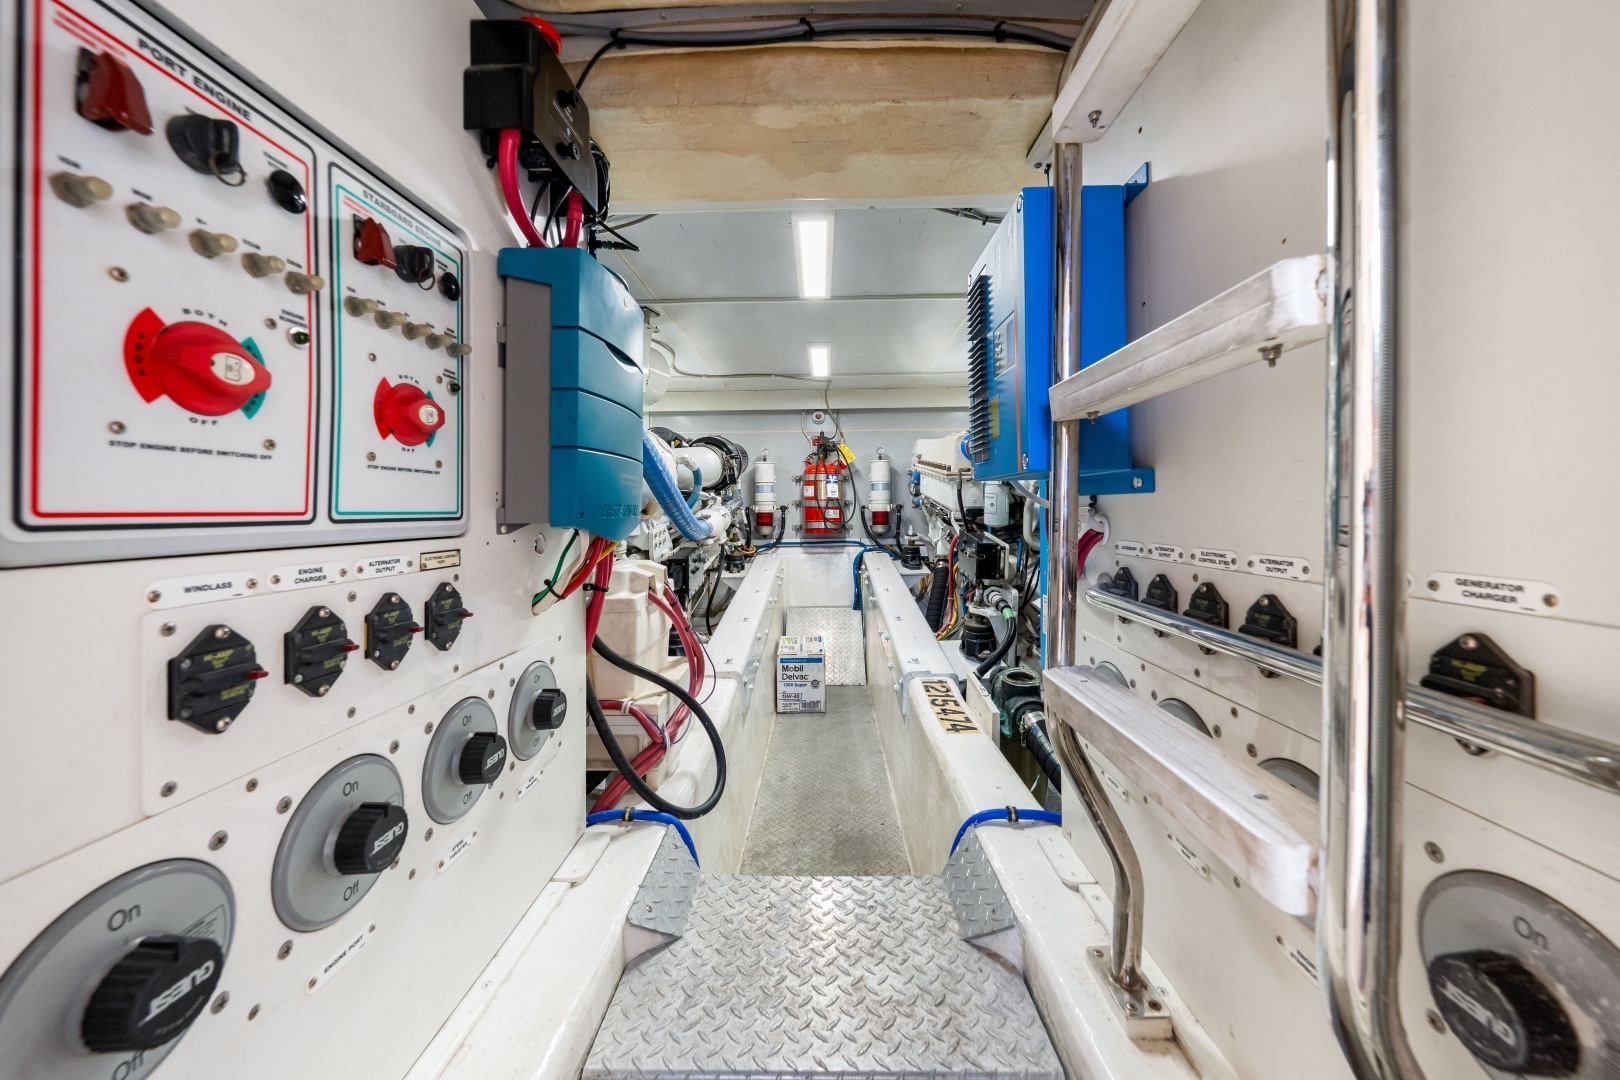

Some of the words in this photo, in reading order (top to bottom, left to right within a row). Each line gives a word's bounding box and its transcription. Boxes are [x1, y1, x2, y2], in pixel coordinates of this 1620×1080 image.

[137, 37, 187, 78] PORT
[192, 75, 252, 122] ENGINE
[363, 190, 413, 228] STARBOARD
[415, 226, 442, 247] ENGINE
[182, 308, 228, 327] BOTH
[398, 374, 420, 384] BOTH
[189, 416, 219, 426] OFF
[108, 440, 136, 448] STOP
[140, 442, 176, 452] ENGINE
[180, 446, 213, 456] BEFORE
[216, 450, 258, 460] SWITCHING
[298, 566, 324, 575] ENGINE
[368, 558, 400, 567] ALTERNATOR
[1259, 558, 1294, 567] ALTERNATOR
[1266, 566, 1288, 574] OUTPUT
[184, 582, 232, 593] WINDLASS
[294, 574, 327, 584] CHARGER
[1455, 578, 1524, 592] GENERATOR
[1462, 590, 1518, 604] CHARGER
[922, 680, 978, 732] 1215474
[462, 715, 472, 726] On
[484, 749, 505, 770] GUEST
[343, 781, 358, 796] On
[462, 789, 473, 805] Off
[369, 821, 404, 858] GUEST
[452, 839, 464, 852] STERN
[449, 842, 468, 861] THRUSTER
[343, 879, 359, 901] Off
[108, 904, 141, 932] On
[1513, 915, 1548, 949] On
[324, 949, 347, 974] ENGINE
[348, 934, 363, 951] PORT
[137, 960, 215, 1028] GUEST
[111, 1051, 144, 1080] Off
